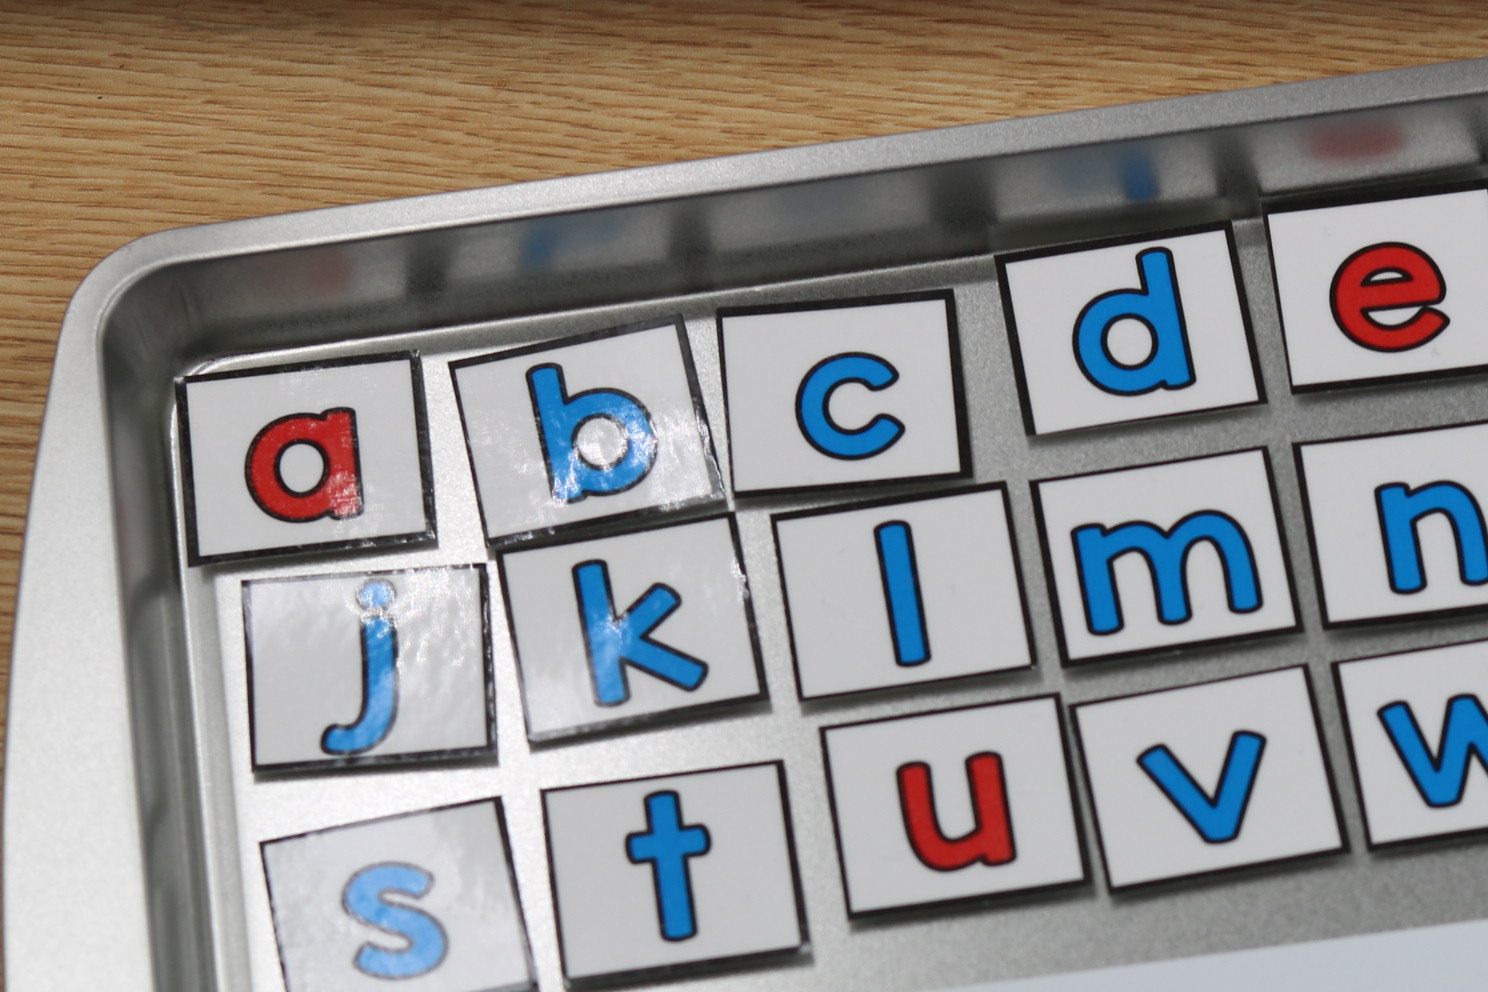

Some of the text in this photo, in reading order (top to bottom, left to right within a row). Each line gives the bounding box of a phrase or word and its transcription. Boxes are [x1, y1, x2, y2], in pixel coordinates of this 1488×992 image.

[250, 411, 357, 519] a
[527, 364, 653, 501] b
[797, 353, 903, 459] c
[1074, 248, 1194, 396] d
[1331, 243, 1447, 352] e
[322, 578, 397, 754] j
[574, 561, 707, 705] k
[876, 522, 930, 666] l
[1073, 511, 1262, 635] m
[346, 865, 446, 977] s
[626, 791, 711, 941] t
[896, 751, 1016, 872] u
[1139, 731, 1265, 844] v
